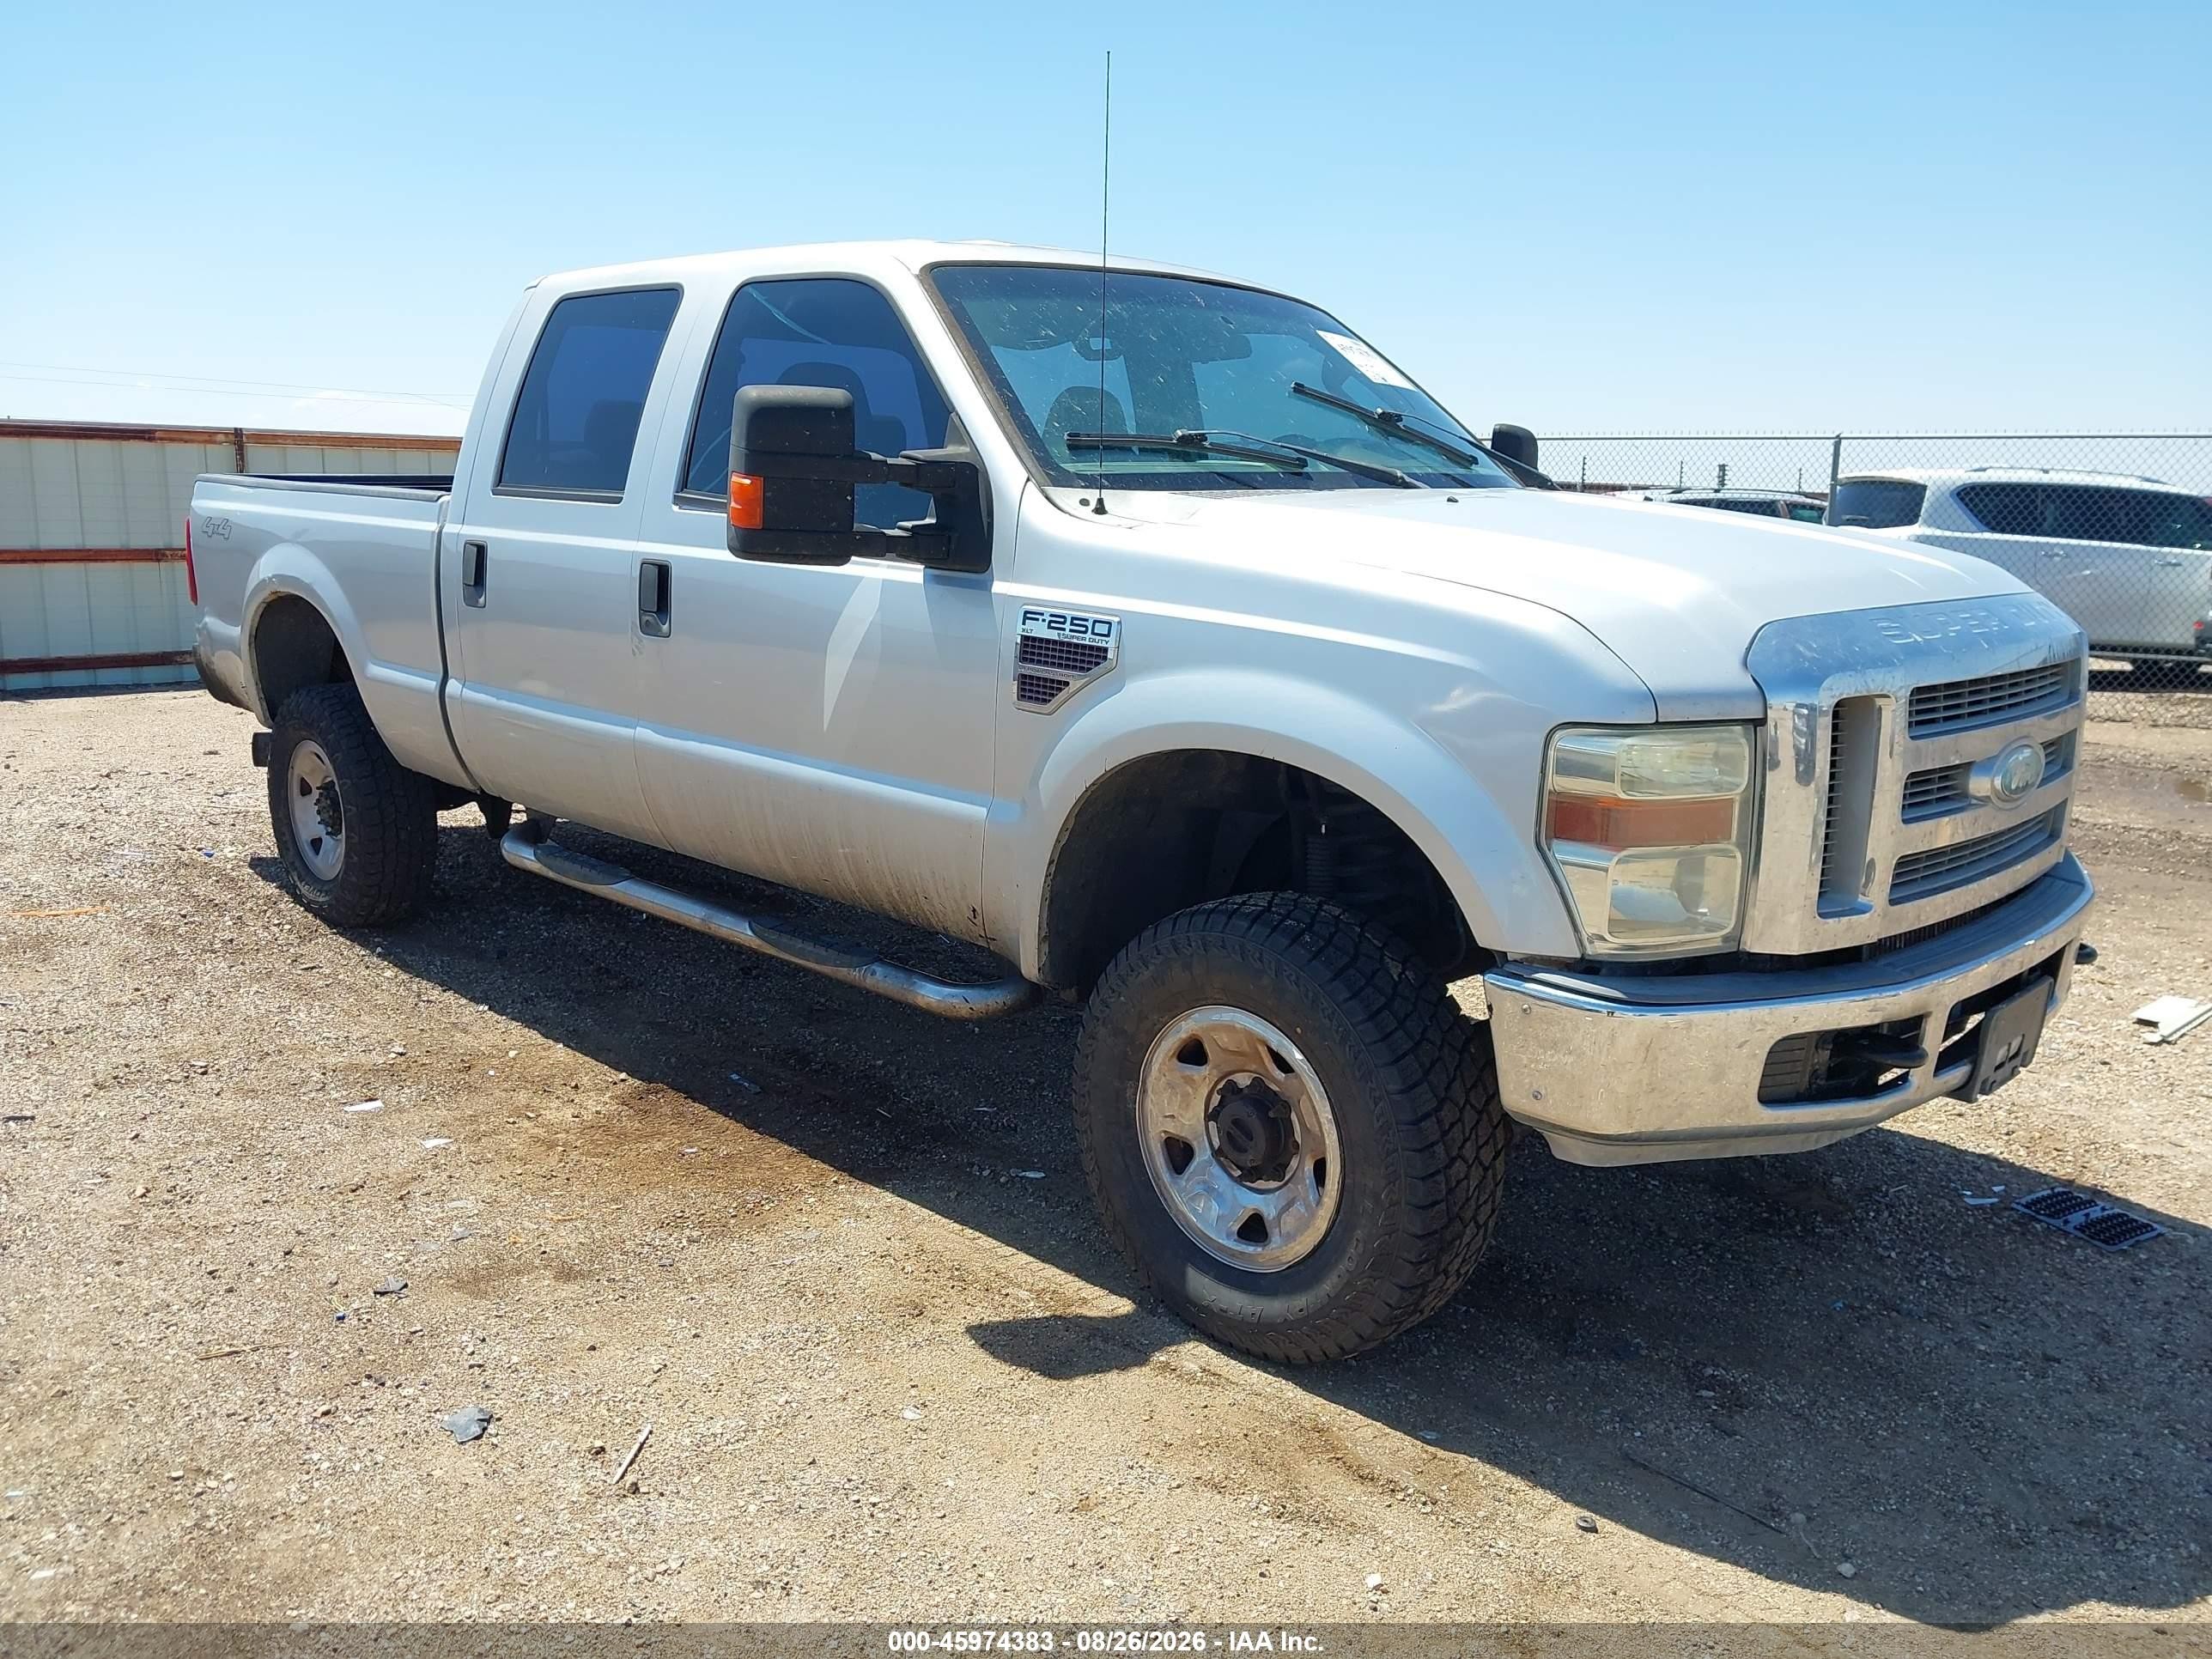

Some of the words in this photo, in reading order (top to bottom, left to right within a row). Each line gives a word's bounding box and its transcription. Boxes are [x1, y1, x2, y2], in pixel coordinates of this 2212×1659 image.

[202, 516, 232, 540] 4x4
[1022, 611, 1113, 637] F-250
[1061, 633, 1086, 642] SUPER
